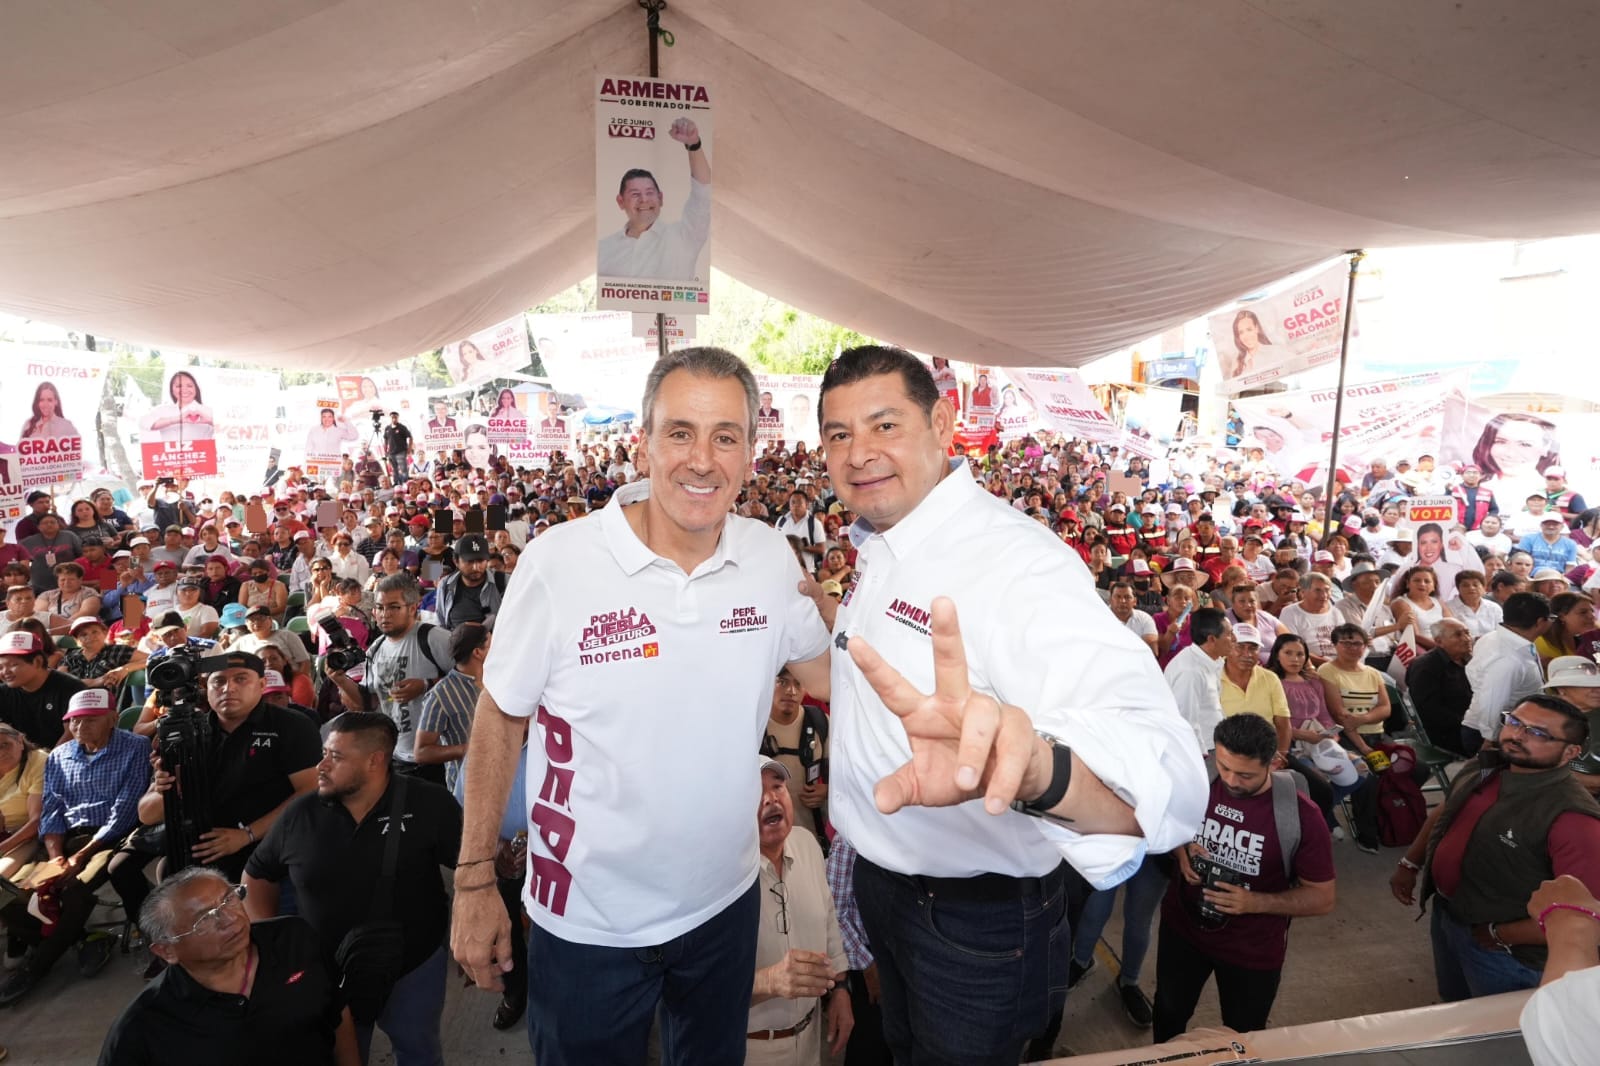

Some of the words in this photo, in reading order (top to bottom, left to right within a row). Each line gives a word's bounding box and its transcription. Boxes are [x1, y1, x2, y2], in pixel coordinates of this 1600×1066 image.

[600, 79, 709, 102] ARMENTA
[620, 99, 691, 110] GOBERNADOR
[609, 126, 654, 139] VOTA
[601, 287, 659, 300] morena
[27, 363, 89, 378] morena
[1310, 384, 1382, 402] moena
[488, 419, 527, 427] GRACE
[18, 437, 81, 455] GRACE
[164, 440, 194, 452] LIZ
[19, 453, 81, 466] PALOMARES
[152, 452, 207, 463] SÁNCHEZ
[1410, 509, 1452, 520] VOTA
[591, 611, 618, 626] POR
[620, 606, 638, 619] LA
[733, 606, 756, 617] PEPE
[889, 599, 933, 629] ARMEN
[583, 613, 651, 641] PUEBLA
[720, 615, 767, 629] CHEDRAUI
[895, 615, 928, 636] GOBERNADOR
[583, 637, 607, 650] DEL
[606, 627, 651, 645] FUTURO
[579, 647, 642, 666] morena
[530, 704, 576, 917] PEPE
[1217, 807, 1241, 822] VOTA
